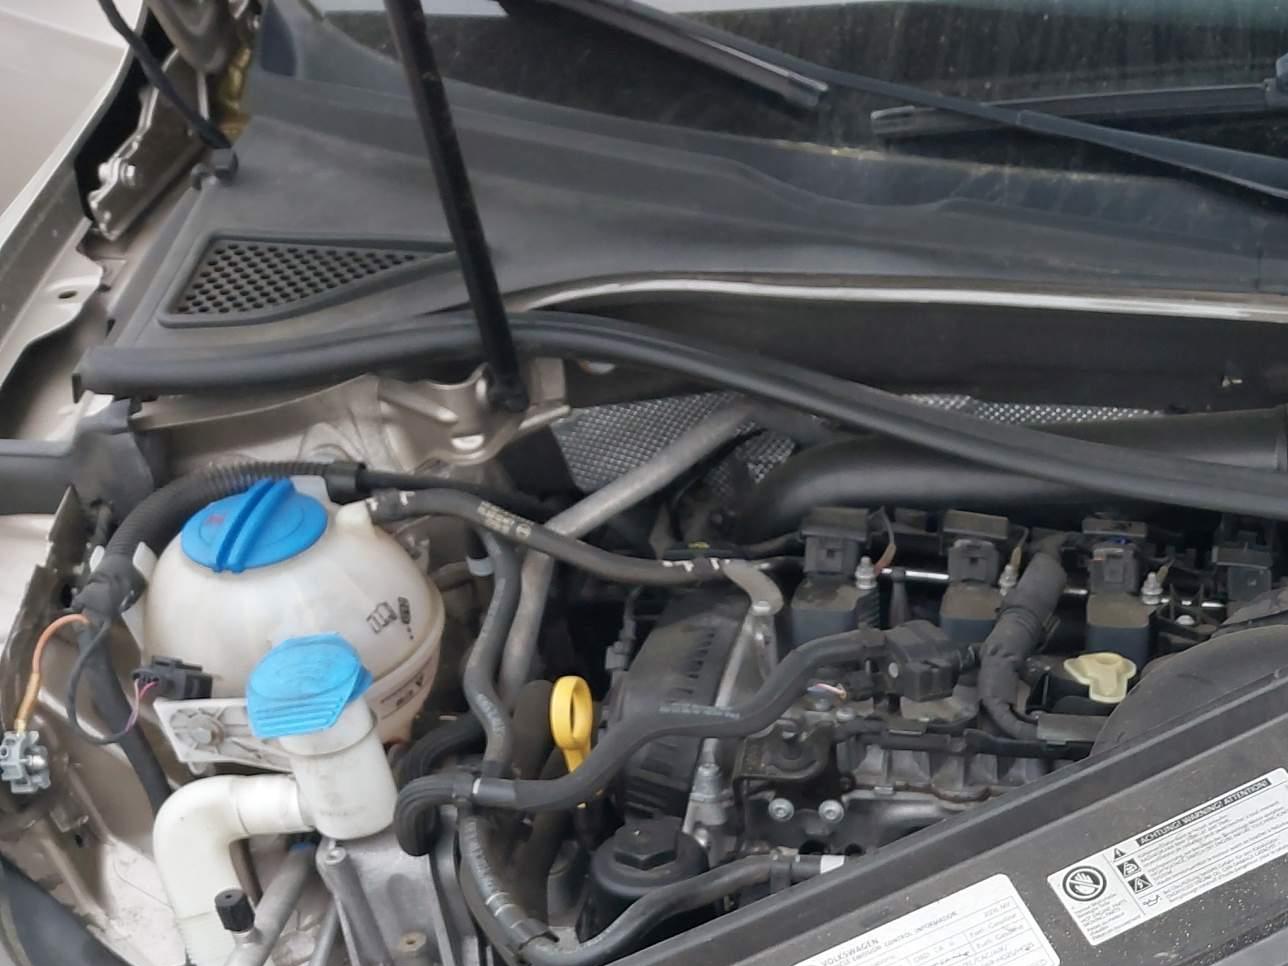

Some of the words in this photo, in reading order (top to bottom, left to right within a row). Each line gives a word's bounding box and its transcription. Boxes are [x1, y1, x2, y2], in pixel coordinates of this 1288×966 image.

[1139, 820, 1183, 845] ACHTUNG!
[1182, 802, 1223, 828] WARNING!
[1223, 780, 1269, 805] ATTENTION!
